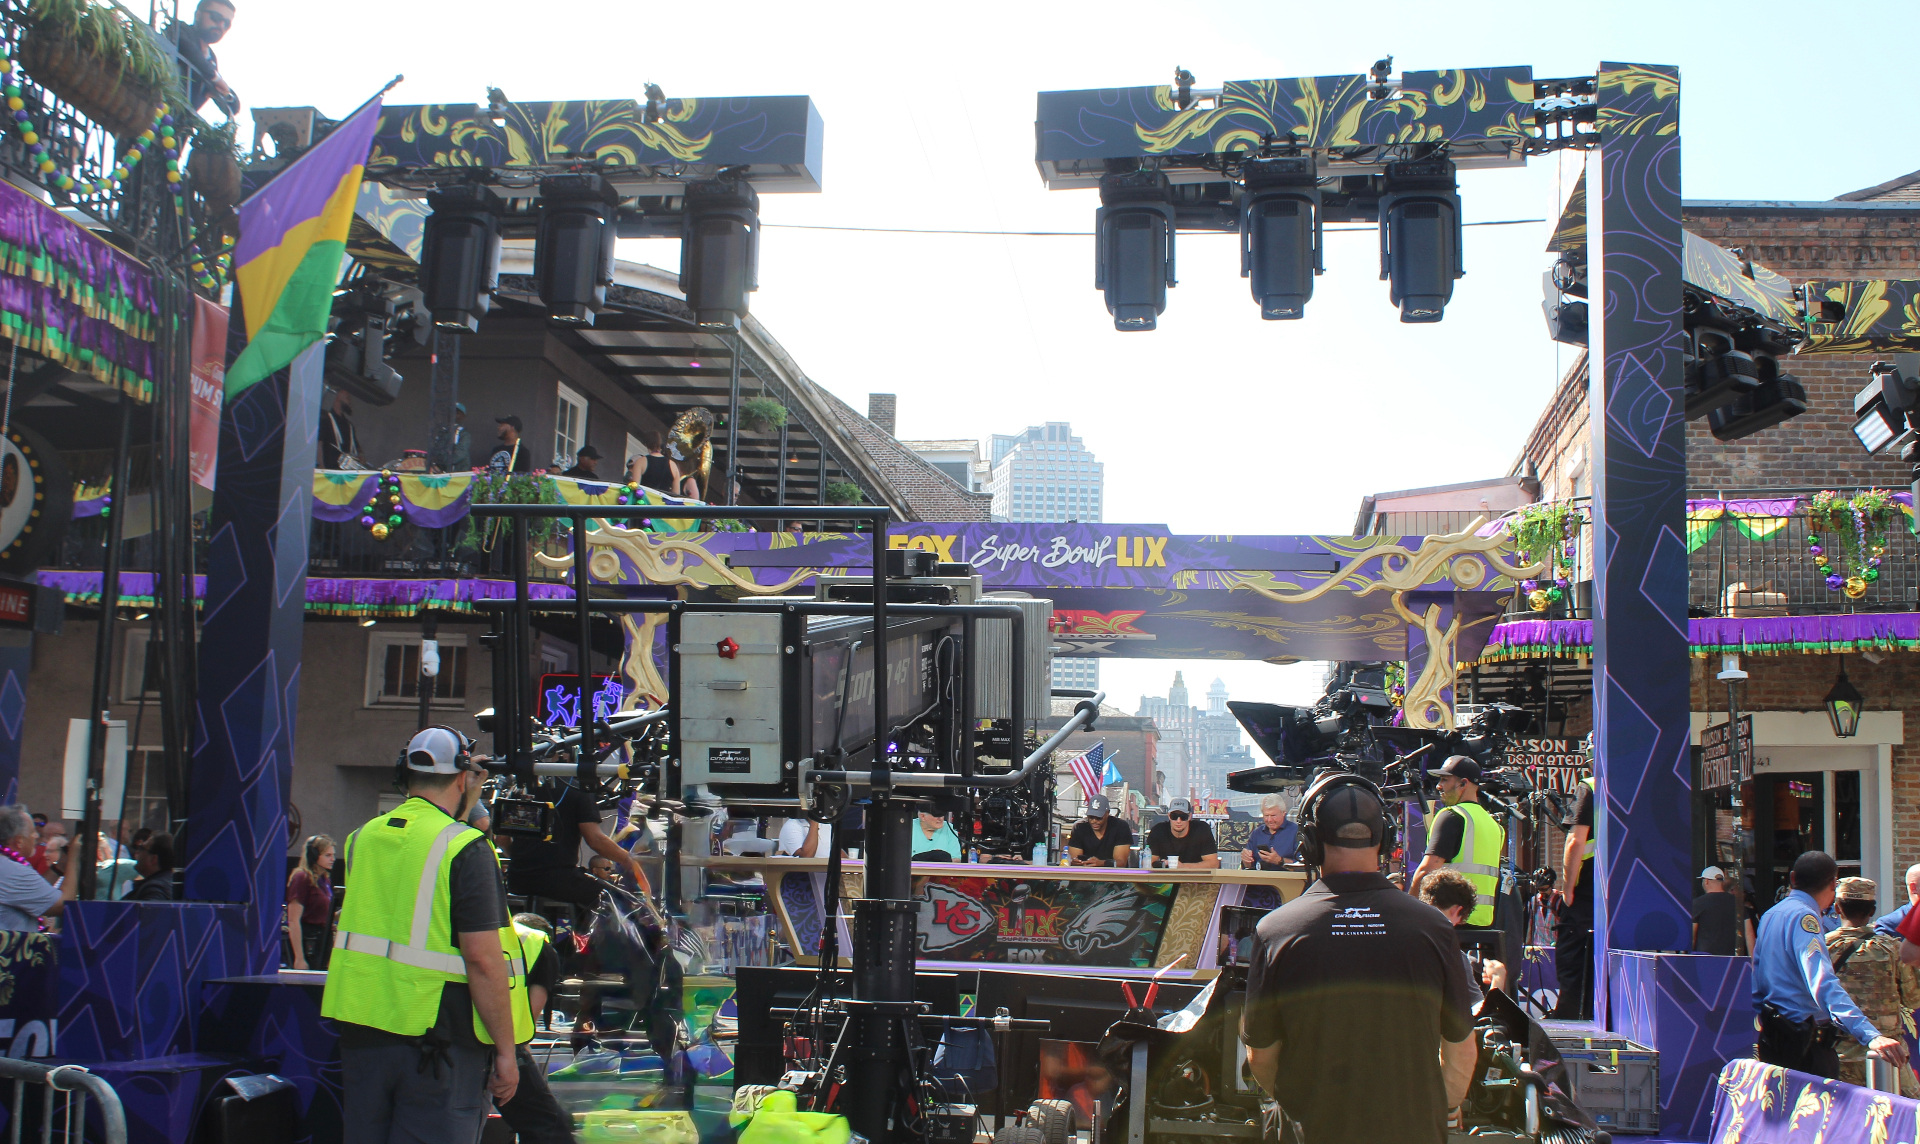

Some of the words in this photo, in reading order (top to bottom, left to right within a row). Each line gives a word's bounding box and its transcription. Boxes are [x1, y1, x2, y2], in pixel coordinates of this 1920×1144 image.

[970, 535, 1038, 571] Super
[1041, 535, 1117, 568] Bowl
[1116, 537, 1167, 567] LIX
[1507, 754, 1584, 766] DEDICATED
[998, 907, 1060, 938] LIX
[1007, 949, 1047, 964] FOX
